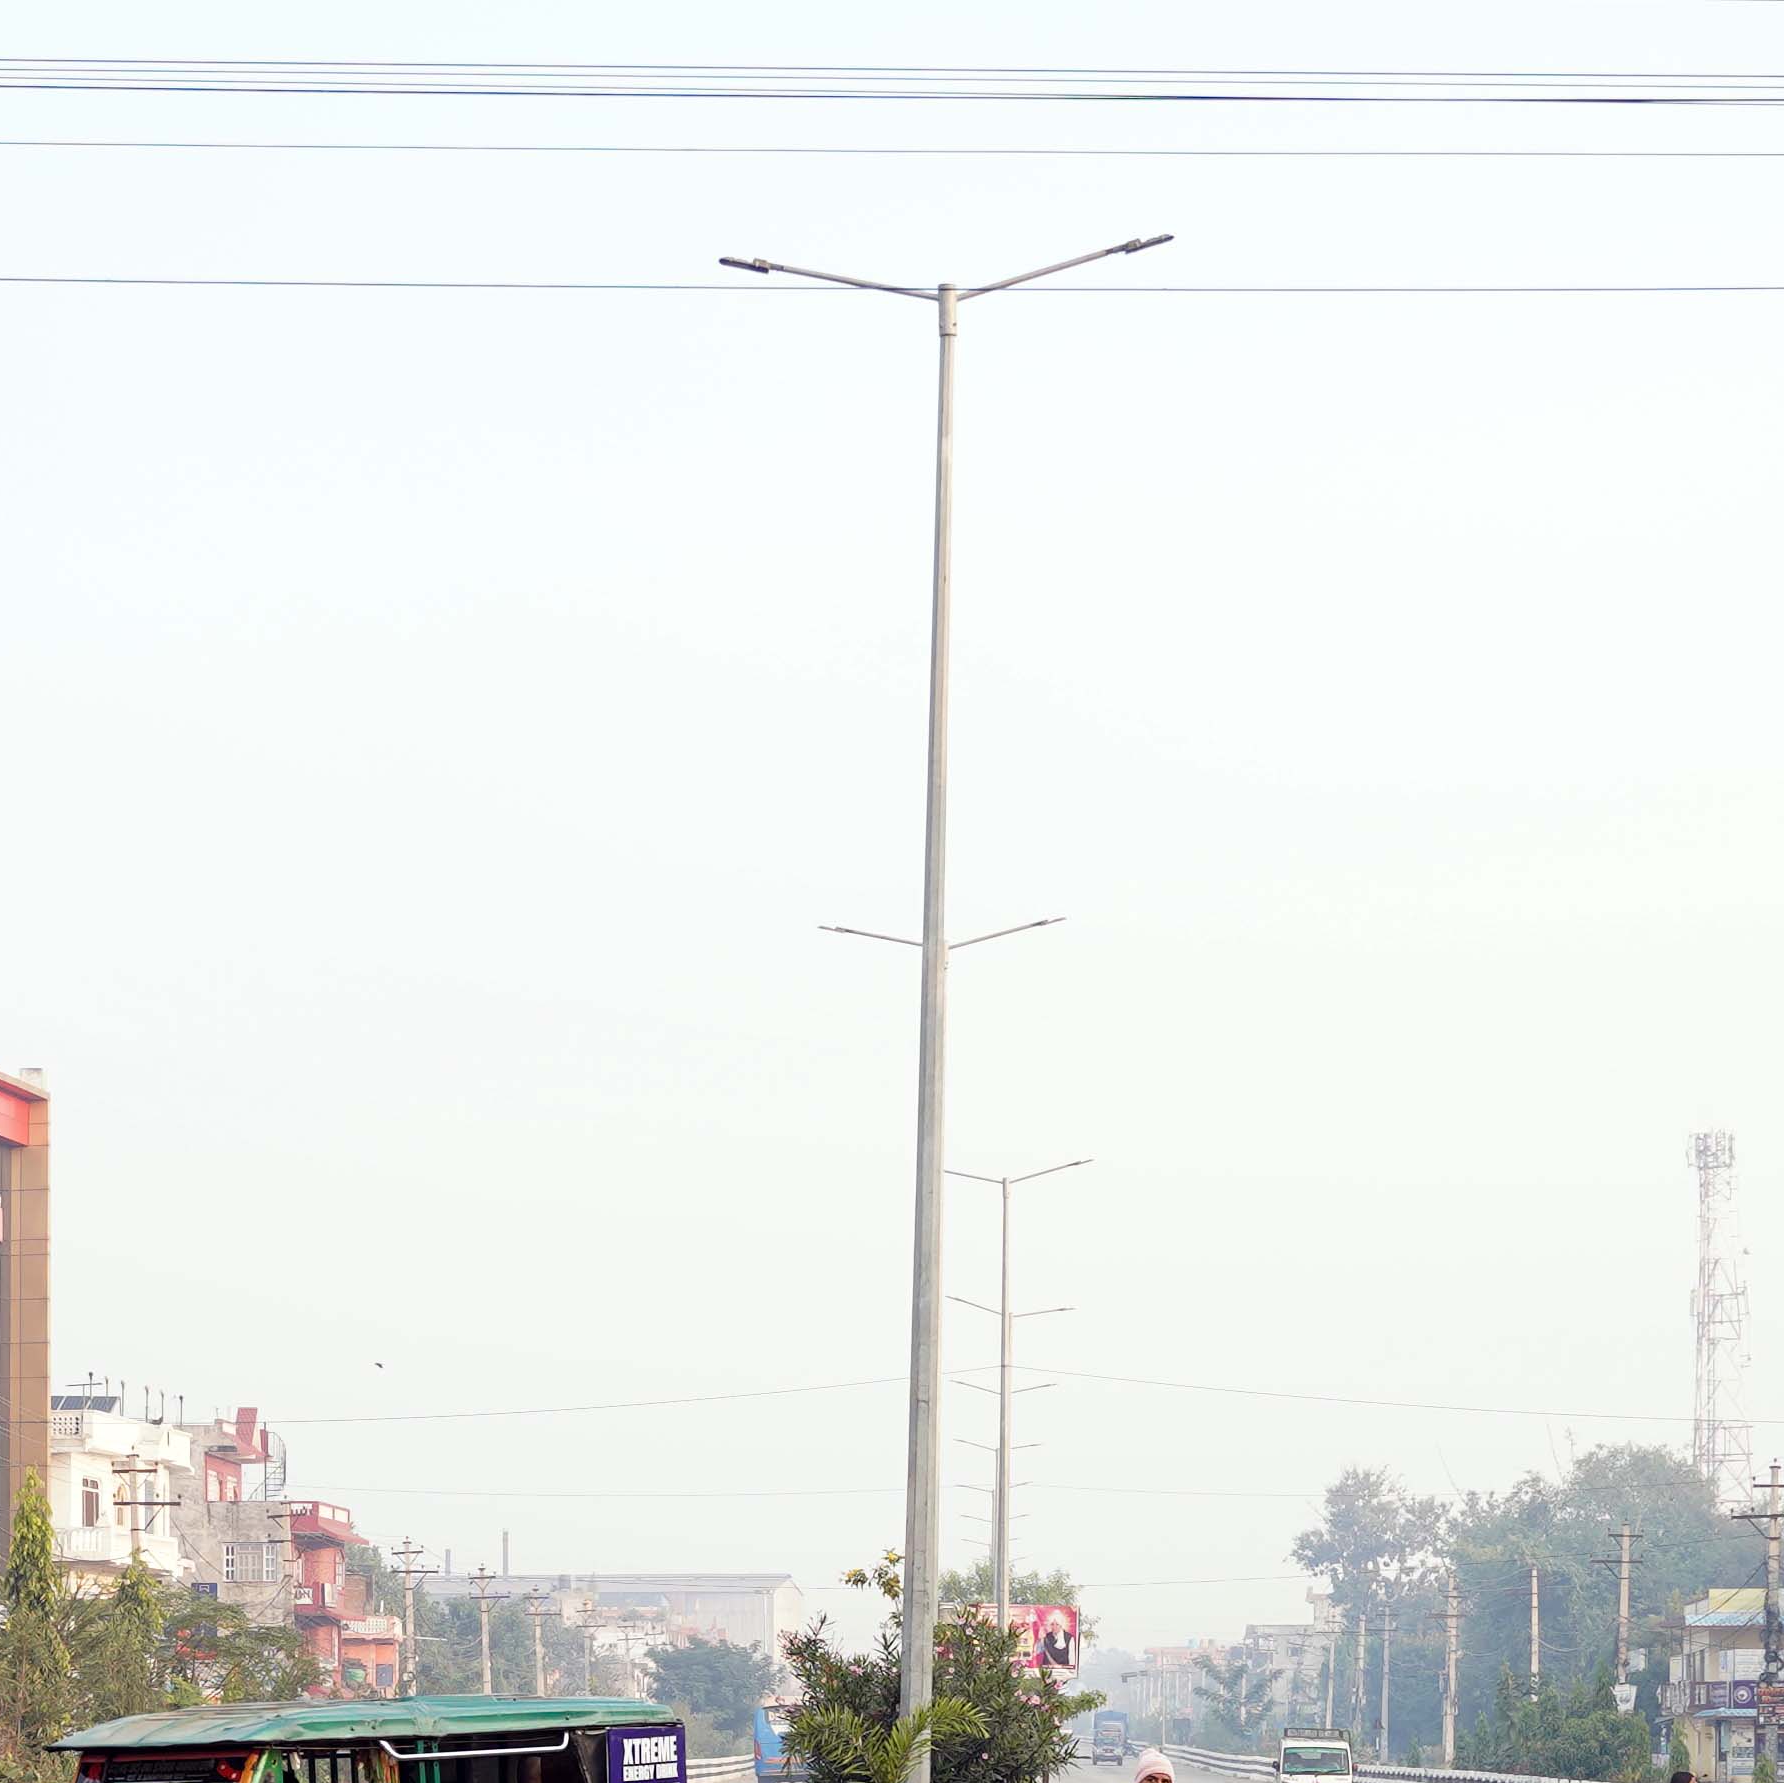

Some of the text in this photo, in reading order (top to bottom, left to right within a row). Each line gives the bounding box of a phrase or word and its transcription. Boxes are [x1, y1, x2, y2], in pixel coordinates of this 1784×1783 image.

[623, 1736, 678, 1765] XTREME
[623, 1763, 679, 1782] ENERGY DRINK
